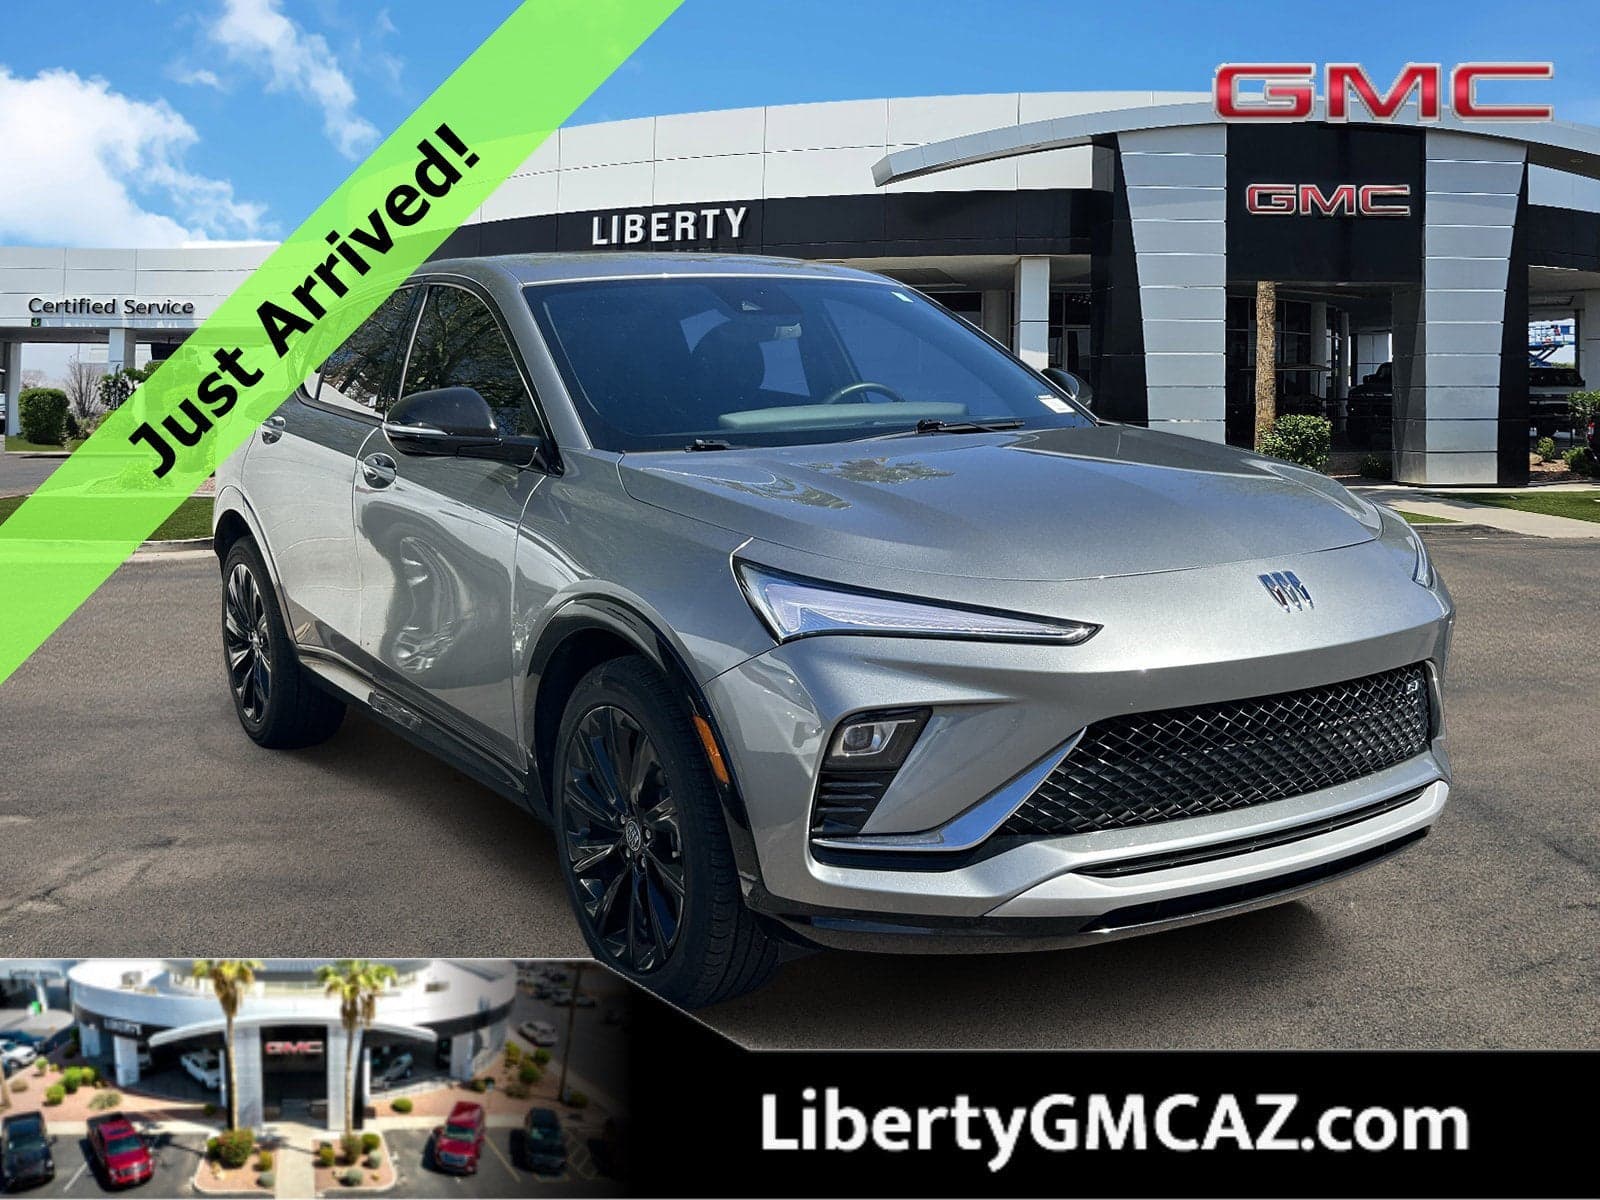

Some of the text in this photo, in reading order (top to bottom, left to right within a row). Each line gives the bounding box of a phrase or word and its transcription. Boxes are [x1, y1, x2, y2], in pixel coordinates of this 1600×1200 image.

[1246, 183, 1411, 217] GMC
[592, 207, 747, 245] LIBERTY
[28, 297, 194, 315] Certified Service
[265, 1041, 323, 1055] GMC
